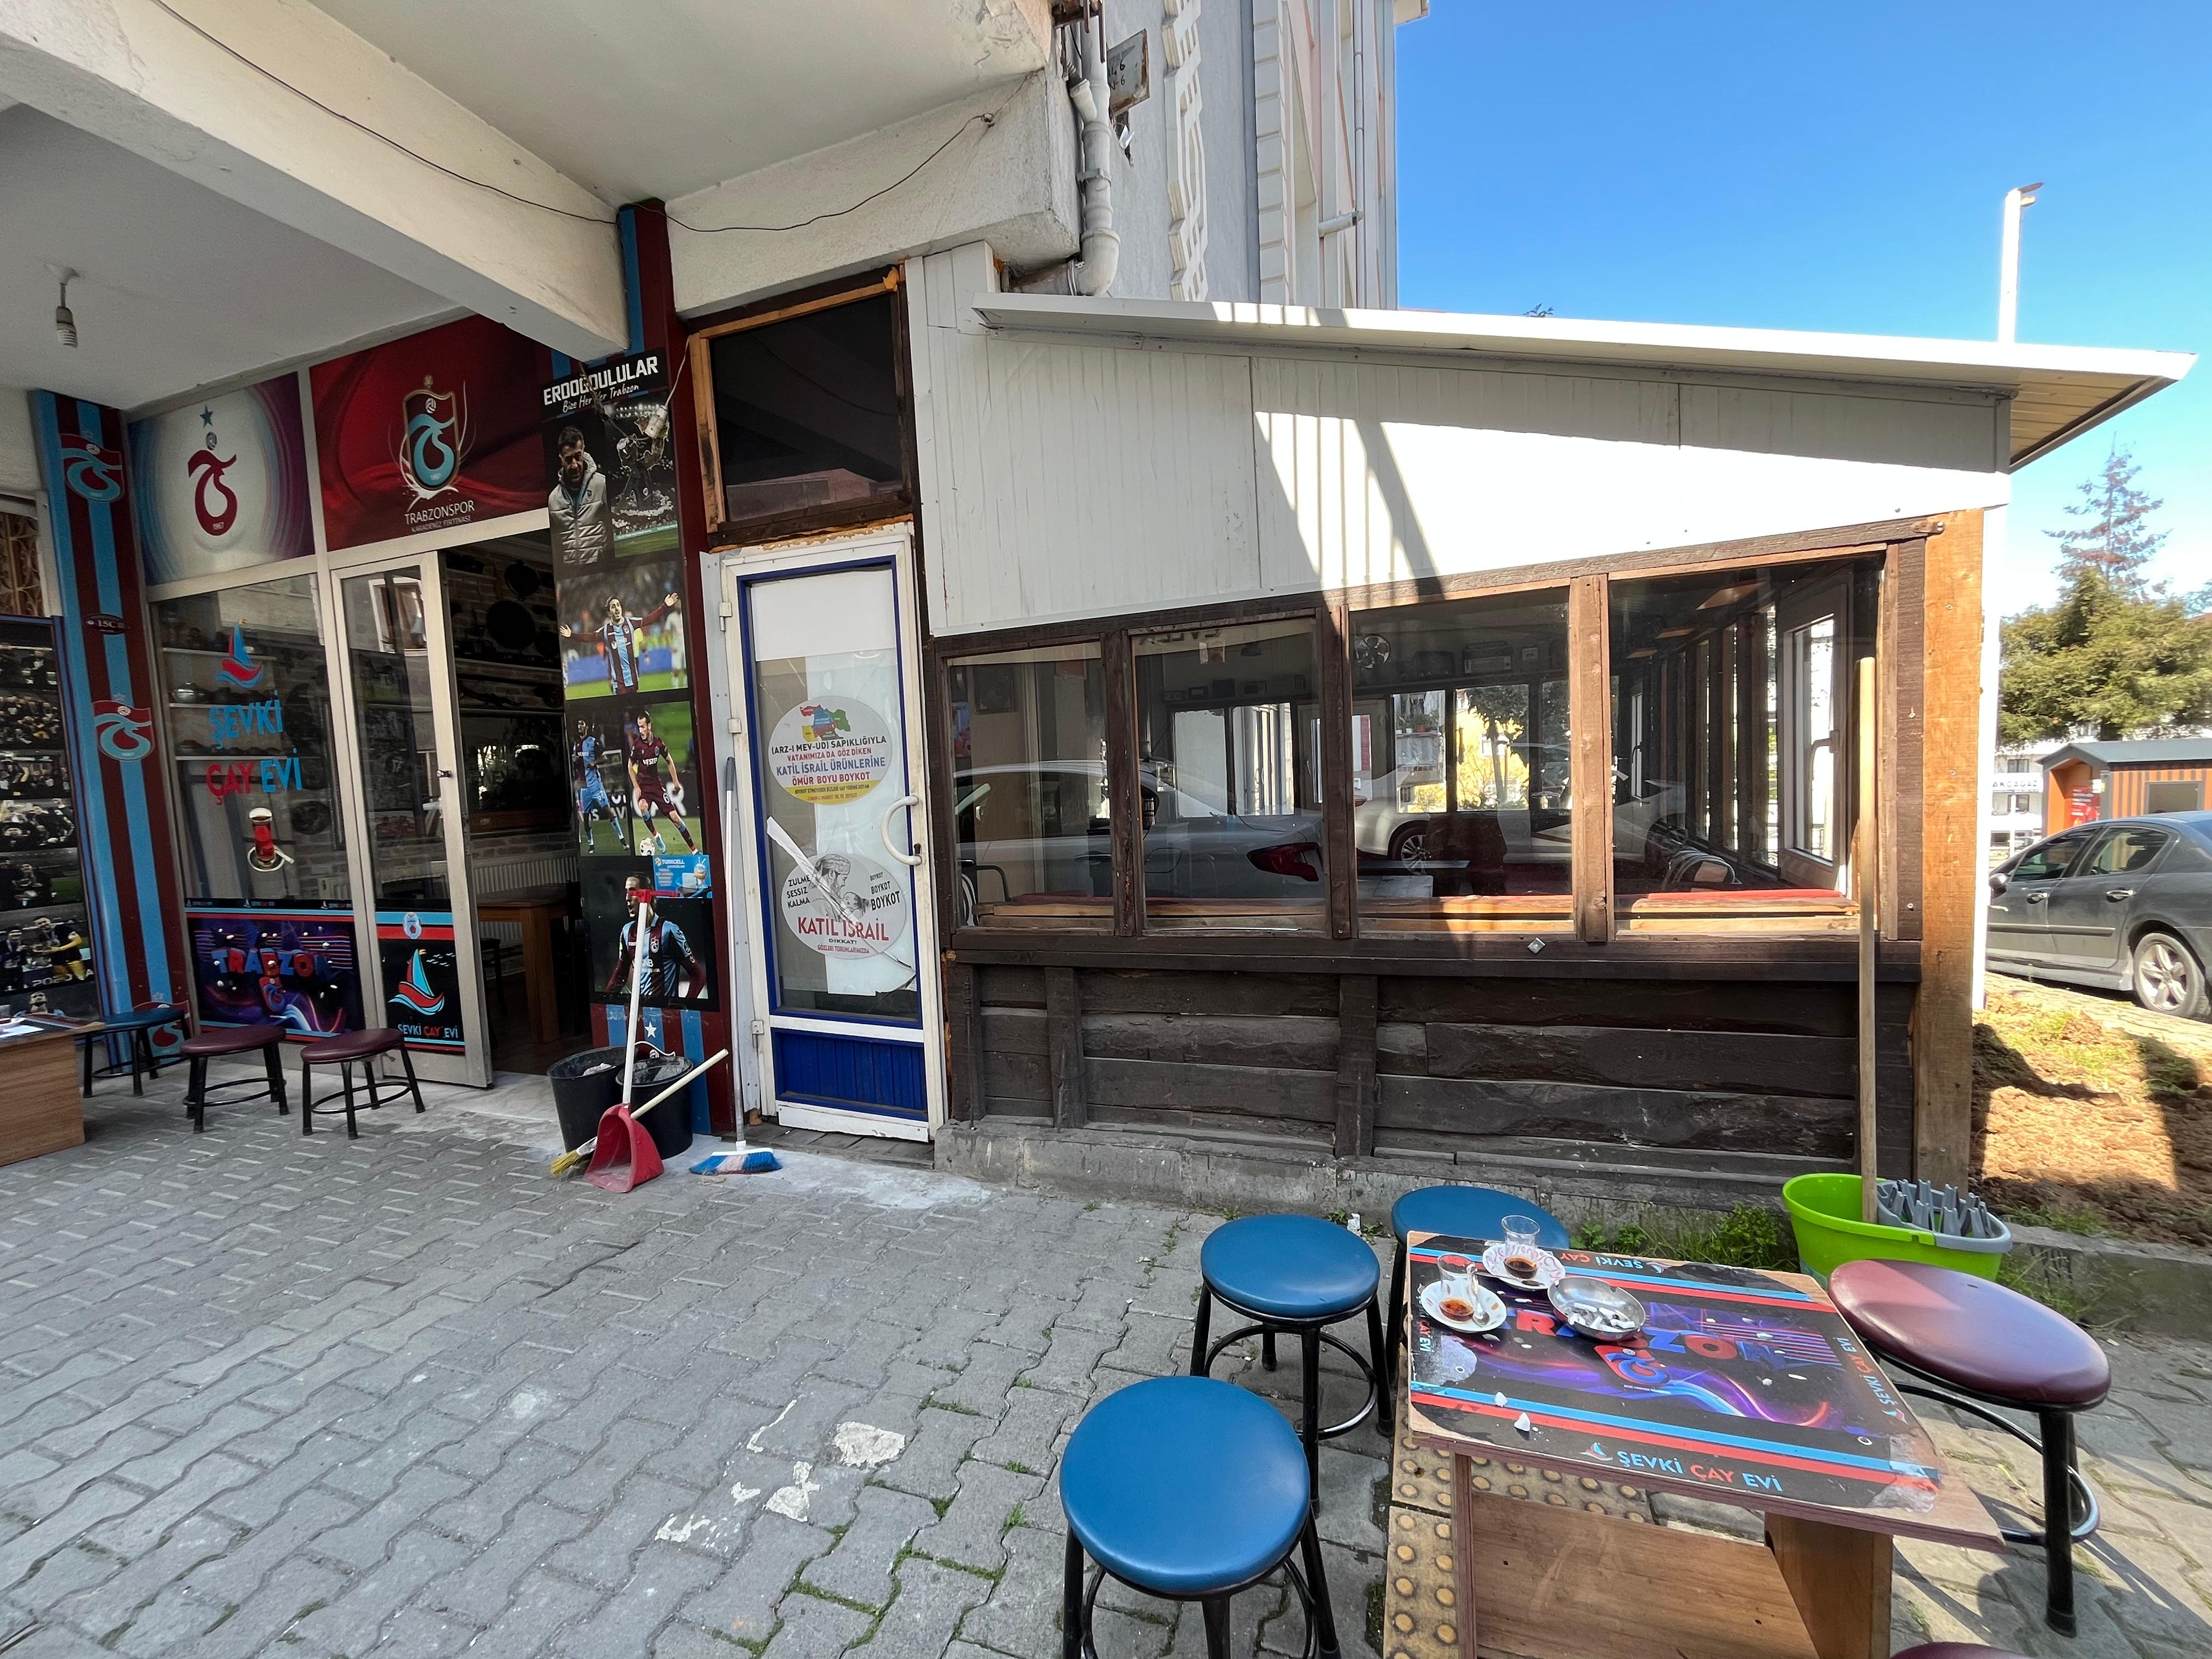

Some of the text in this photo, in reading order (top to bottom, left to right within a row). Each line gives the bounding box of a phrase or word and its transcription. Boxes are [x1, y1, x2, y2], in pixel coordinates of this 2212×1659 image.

[610, 383, 639, 399] Trabzon
[404, 500, 475, 524] TRABZONSPOR
[787, 752, 825, 762] VATANIMIZA
[838, 748, 850, 757] GÖZ
[206, 747, 302, 805] ÇAY EVİ
[776, 762, 800, 776] KATİL
[792, 772, 870, 786] ÖMÜR BOYU BOYKOT
[788, 875, 810, 887] ZULME
[871, 881, 890, 894] BOYKOT
[788, 897, 810, 909] KALMA
[871, 891, 900, 911] BOYKOT
[1617, 1451, 1783, 1492] ŞEVKİ ÇAY EVİ
